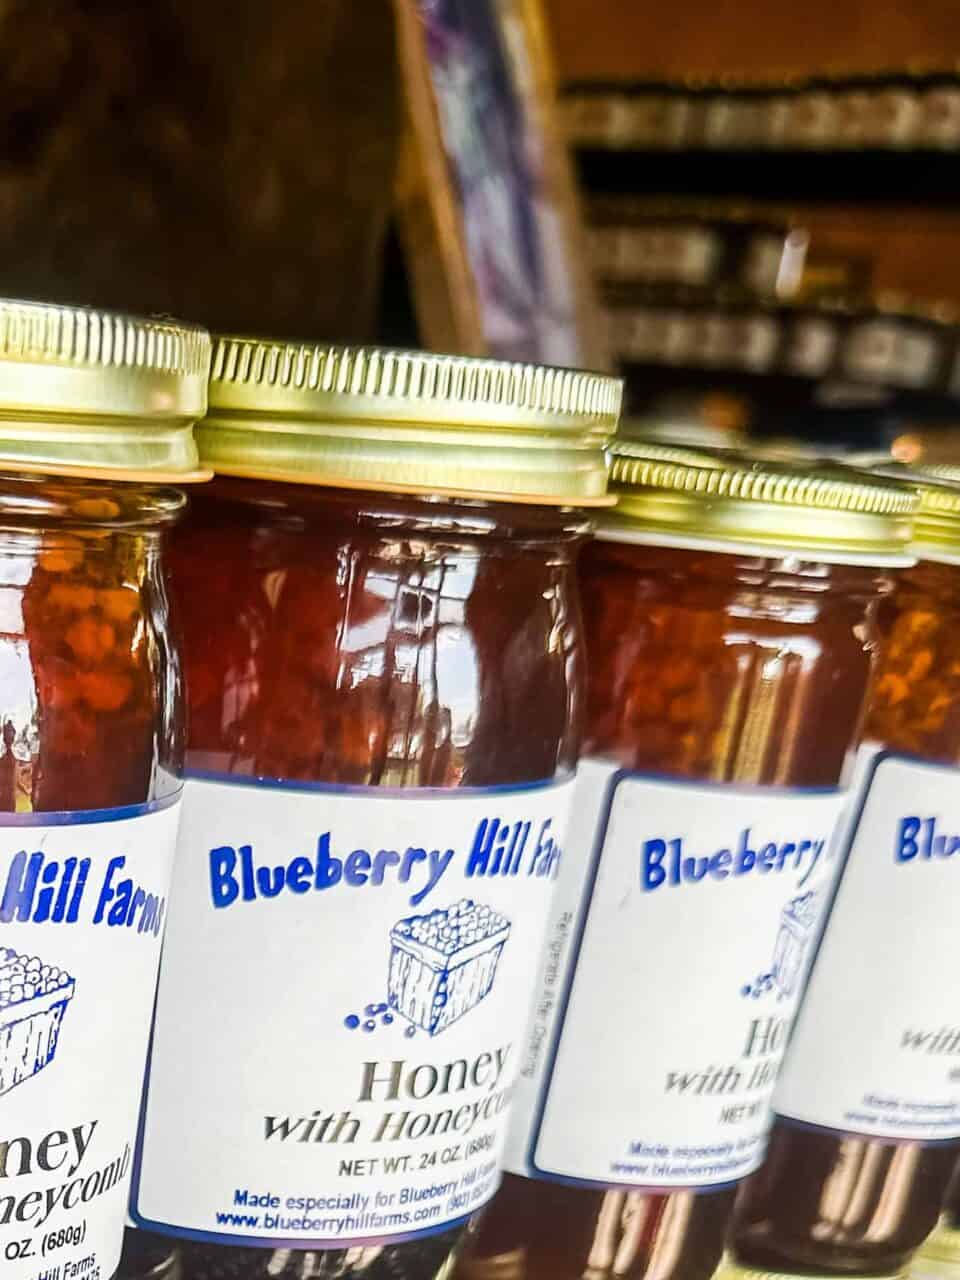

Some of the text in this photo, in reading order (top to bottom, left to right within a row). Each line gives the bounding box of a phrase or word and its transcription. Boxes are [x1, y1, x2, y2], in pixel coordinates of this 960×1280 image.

[208, 831, 455, 909] Blueberry
[464, 817, 532, 878] Hill
[642, 828, 825, 891] Blueberry
[93, 855, 166, 938] Farms
[357, 1043, 513, 1102] Honey
[664, 1065, 741, 1095] with
[263, 1110, 361, 1144] with
[338, 1160, 378, 1177] NET
[383, 1156, 414, 1175] WT.
[419, 1152, 437, 1170] 24
[234, 1189, 280, 1208] Made
[285, 1193, 369, 1215] especially
[375, 1191, 395, 1208] for
[399, 1177, 458, 1204] Blueberry
[4, 1239, 36, 1262] OZ.
[41, 1219, 87, 1257] (680g)
